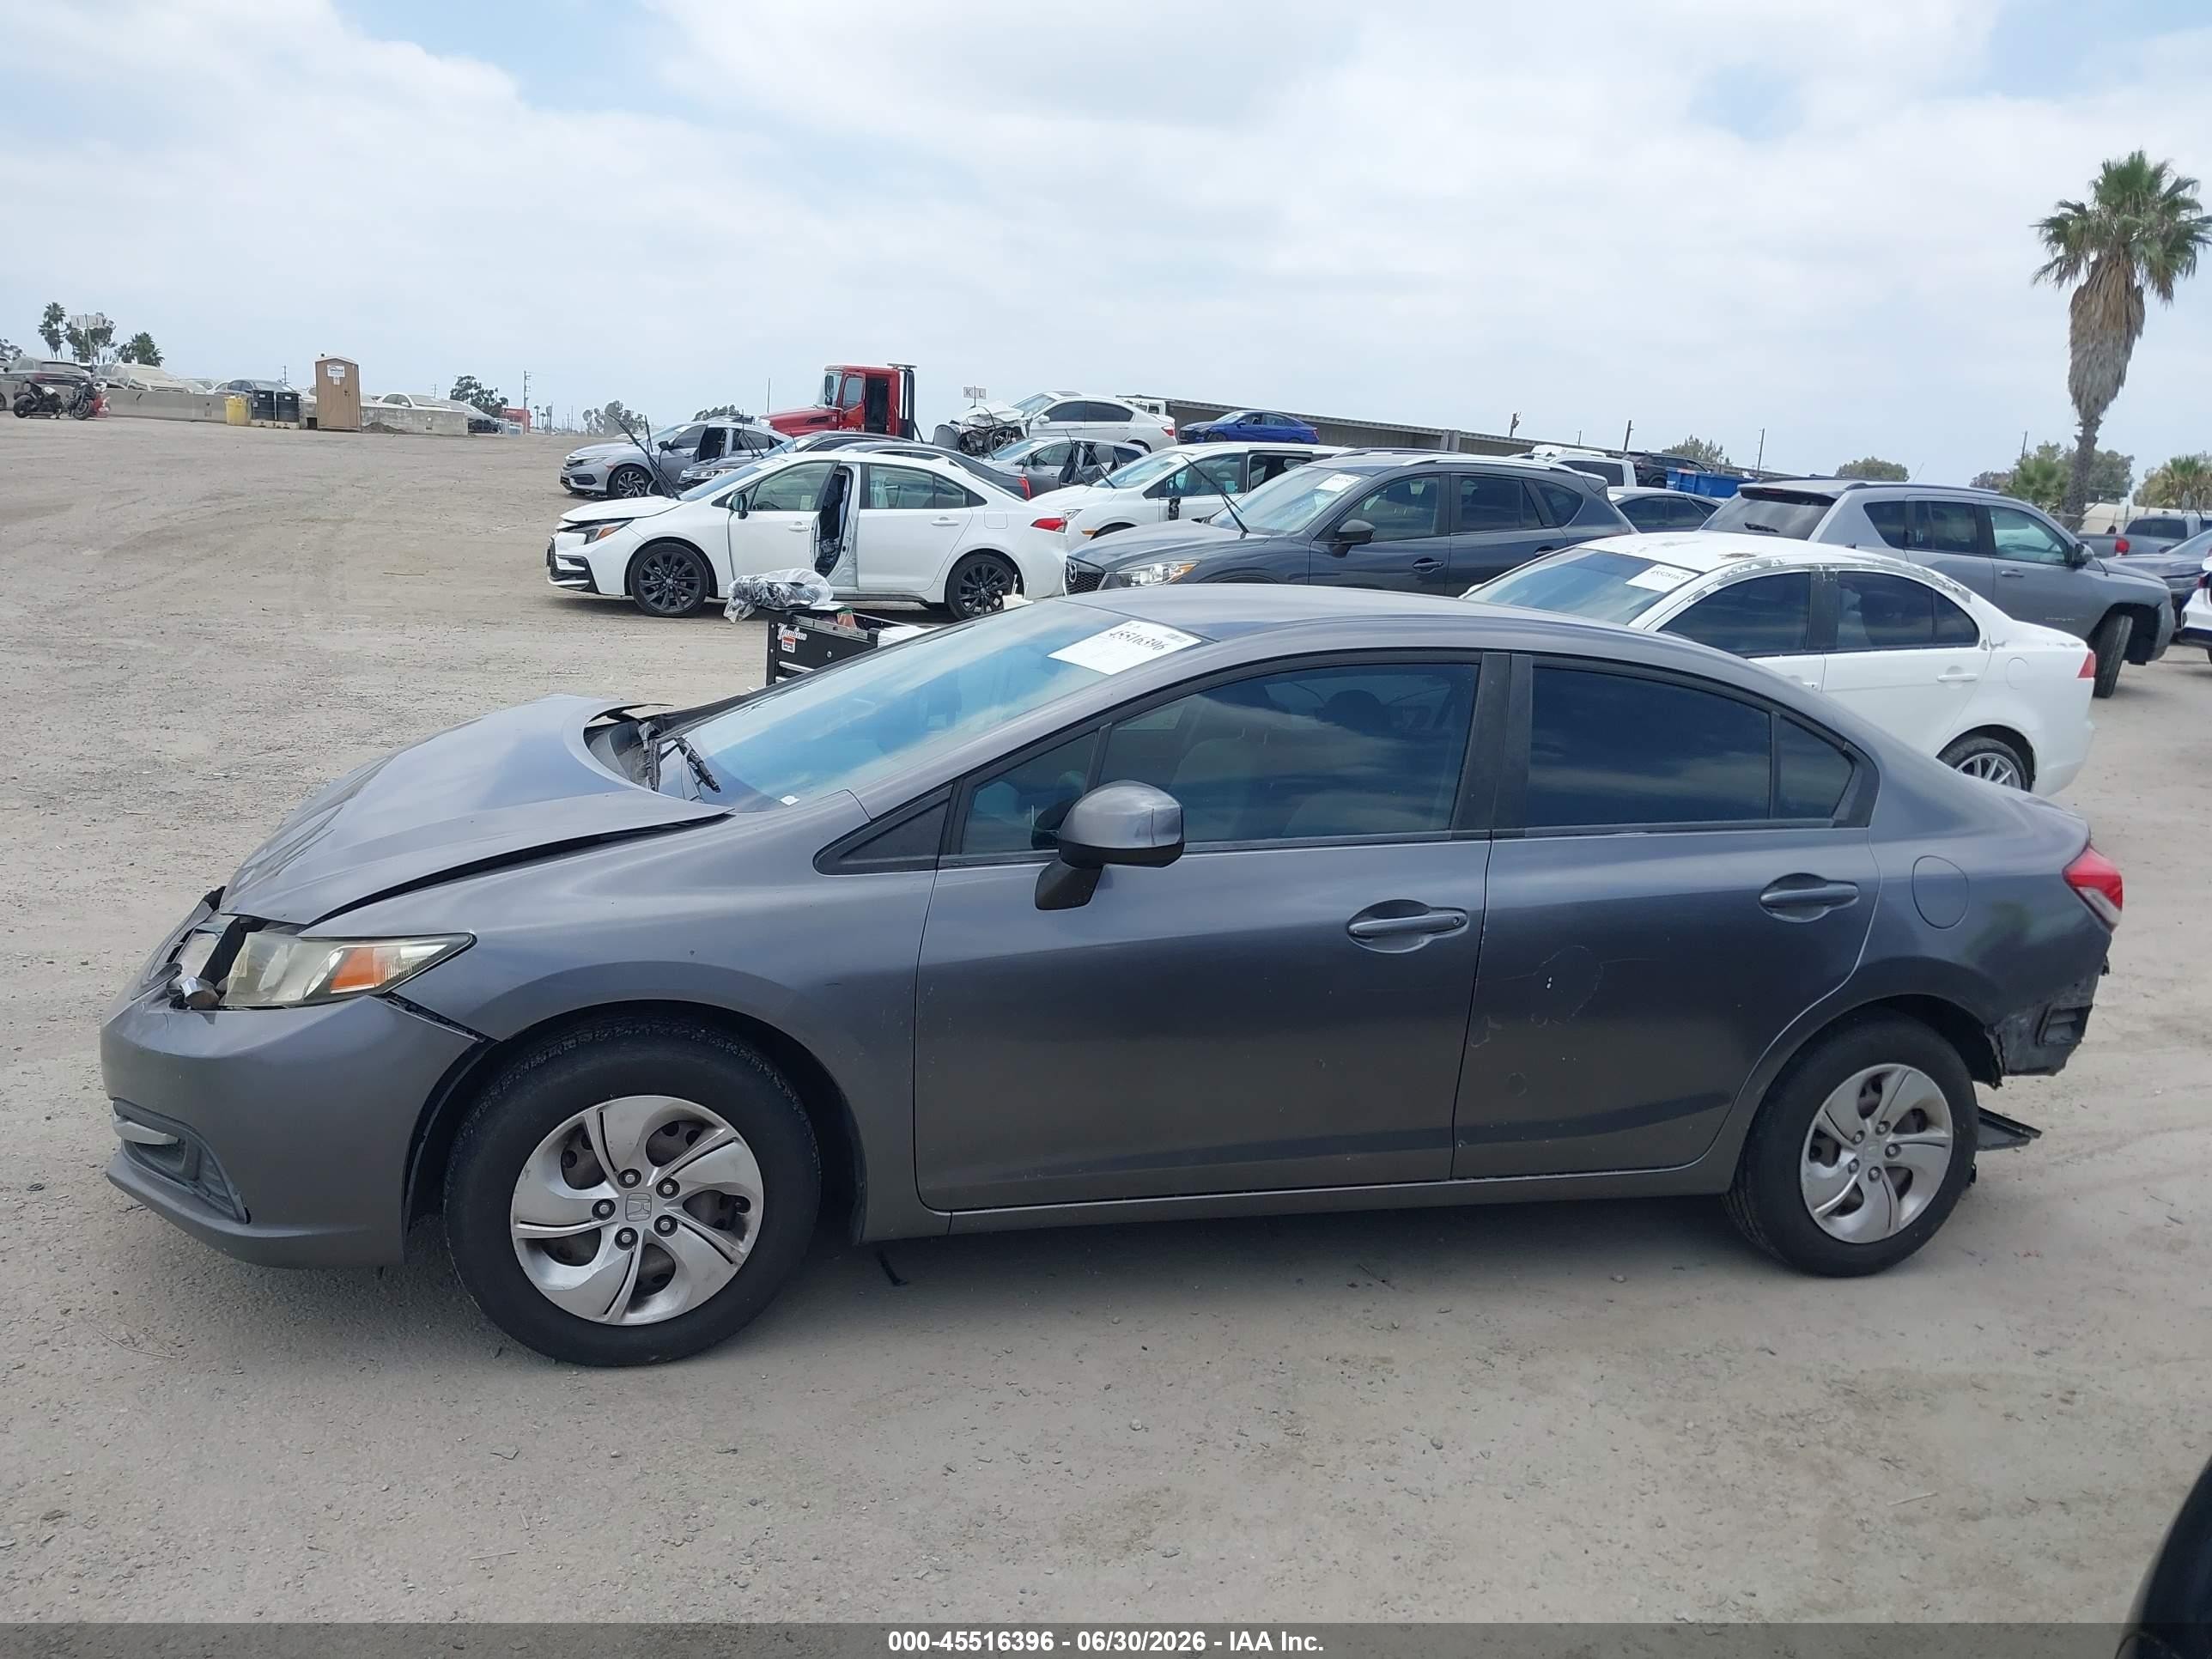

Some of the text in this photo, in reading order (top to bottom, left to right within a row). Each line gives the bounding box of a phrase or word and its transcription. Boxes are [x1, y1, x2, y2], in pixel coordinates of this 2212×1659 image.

[965, 388, 984, 398] K L
[1109, 629, 1170, 652] 45516396
